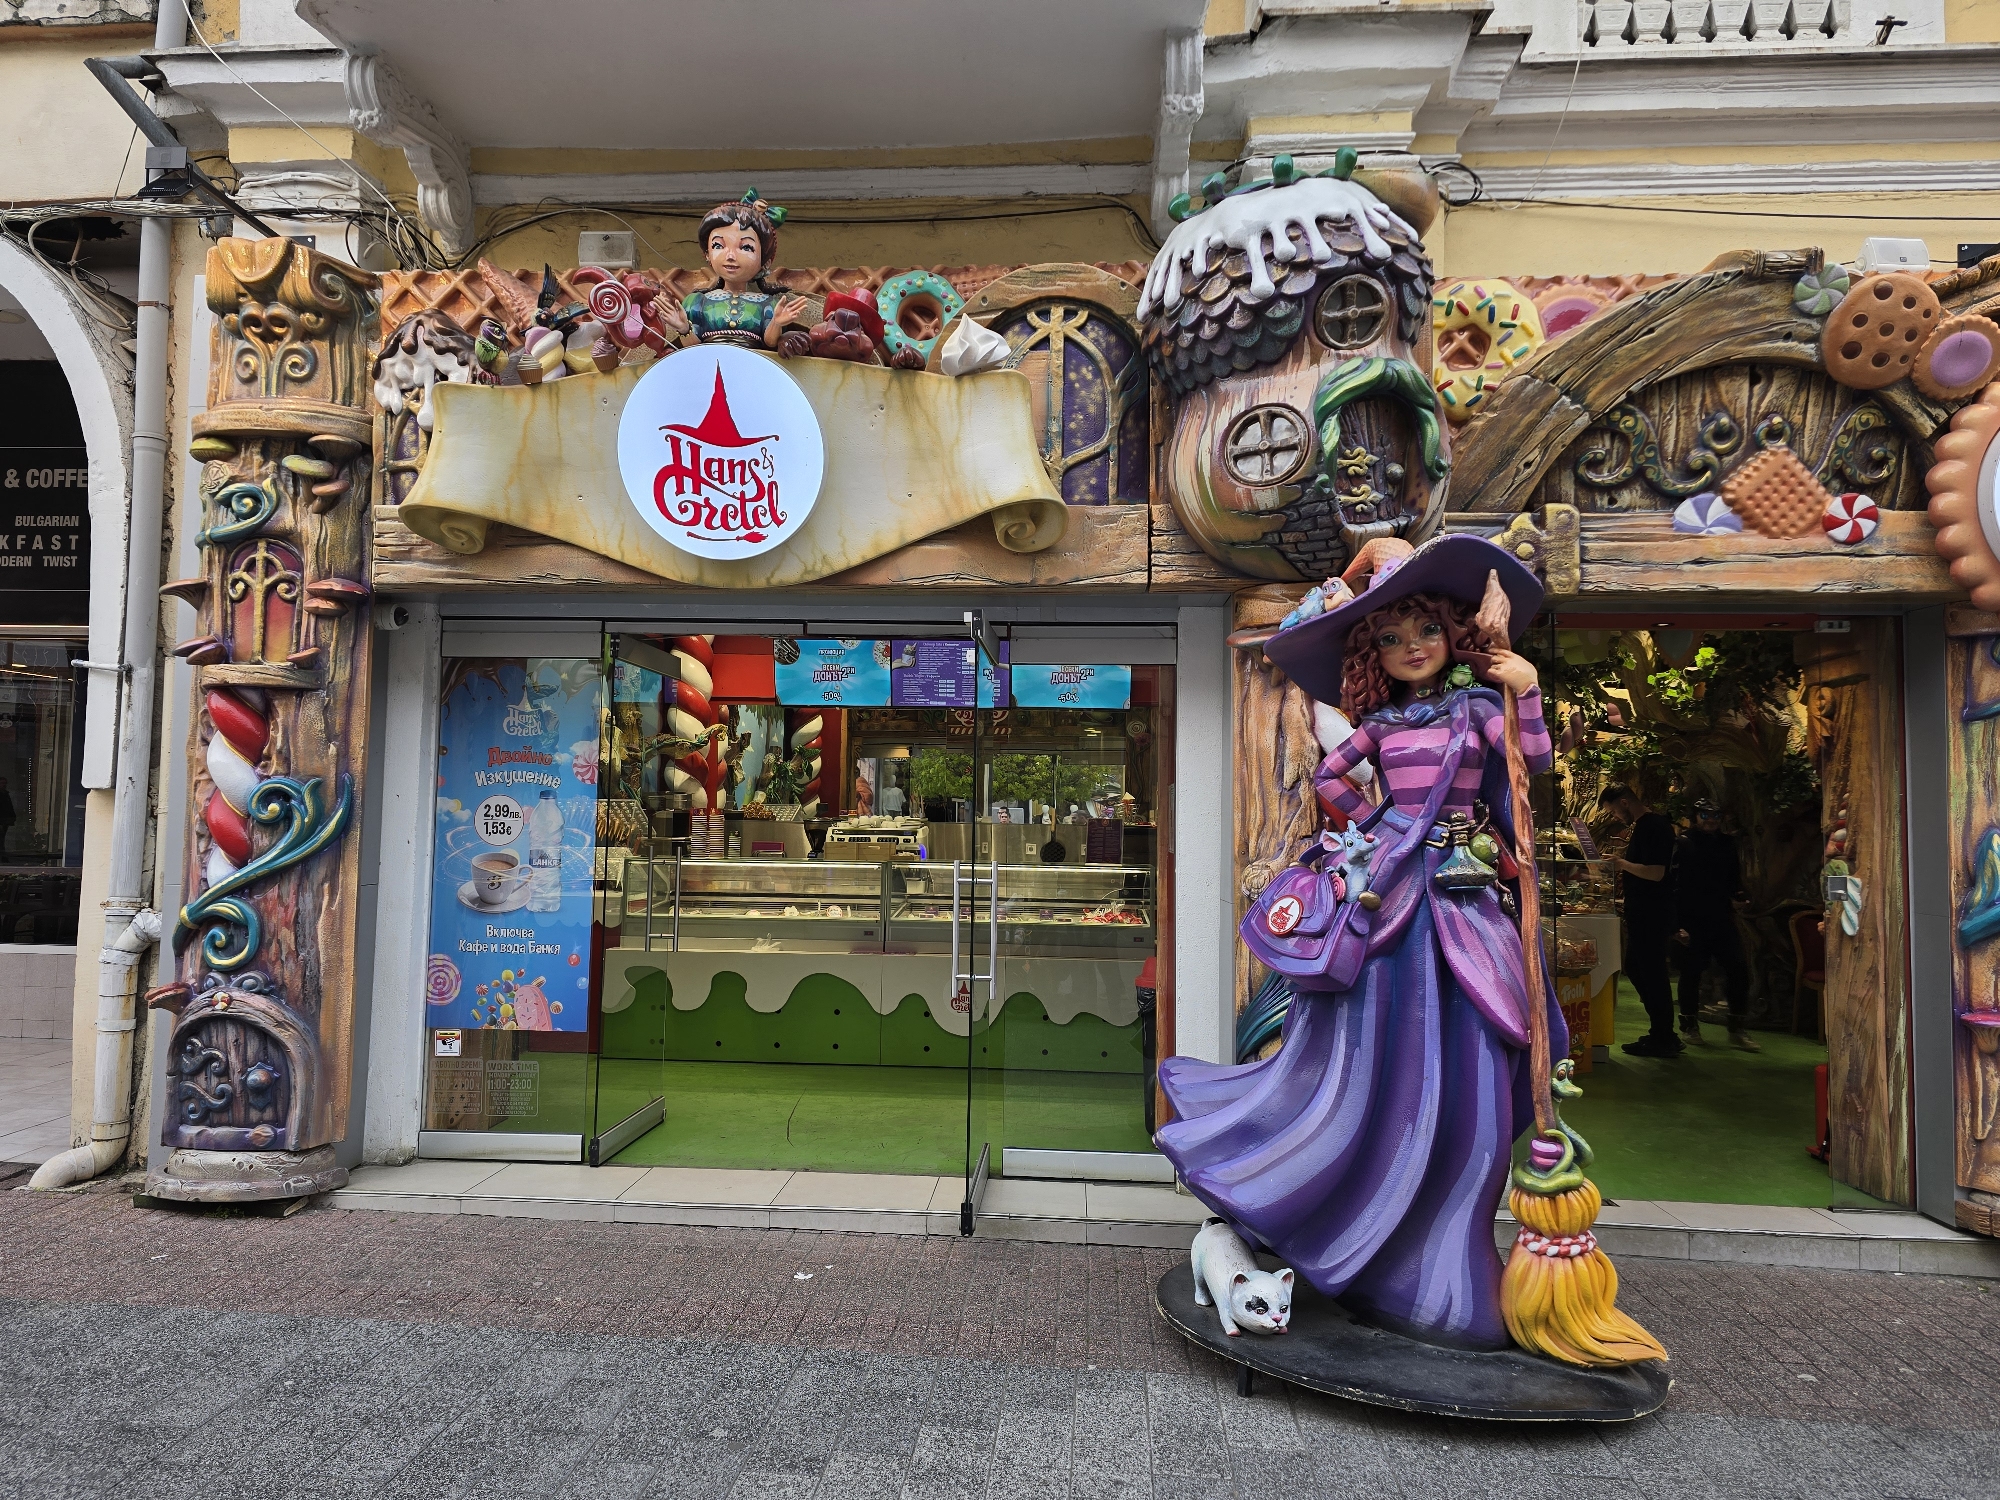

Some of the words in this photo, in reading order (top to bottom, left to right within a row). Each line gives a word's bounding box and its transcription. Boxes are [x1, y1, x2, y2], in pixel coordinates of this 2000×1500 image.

[664, 434, 766, 502] Hans
[761, 446, 774, 478] &
[4, 468, 20, 488] &
[653, 464, 788, 532] Gretel
[15, 515, 79, 527] BULGARIAN
[0, 556, 32, 567] DERN
[43, 556, 78, 567] TWIST
[502, 716, 543, 736] Gretel
[508, 708, 537, 728] Hans
[488, 746, 552, 768] Двойно
[474, 770, 562, 788] Изкушение
[484, 822, 512, 836] 1,53€
[486, 924, 534, 938] Включва
[458, 940, 488, 956] Кафе
[490, 942, 498, 953] и
[500, 942, 526, 954] вода
[528, 940, 560, 954] Банкя
[1561, 983, 1585, 1004] Trolli
[433, 1060, 460, 1069] АБОТНО
[488, 1062, 514, 1071] WORK
[487, 1078, 532, 1090] 11:00-23:00
